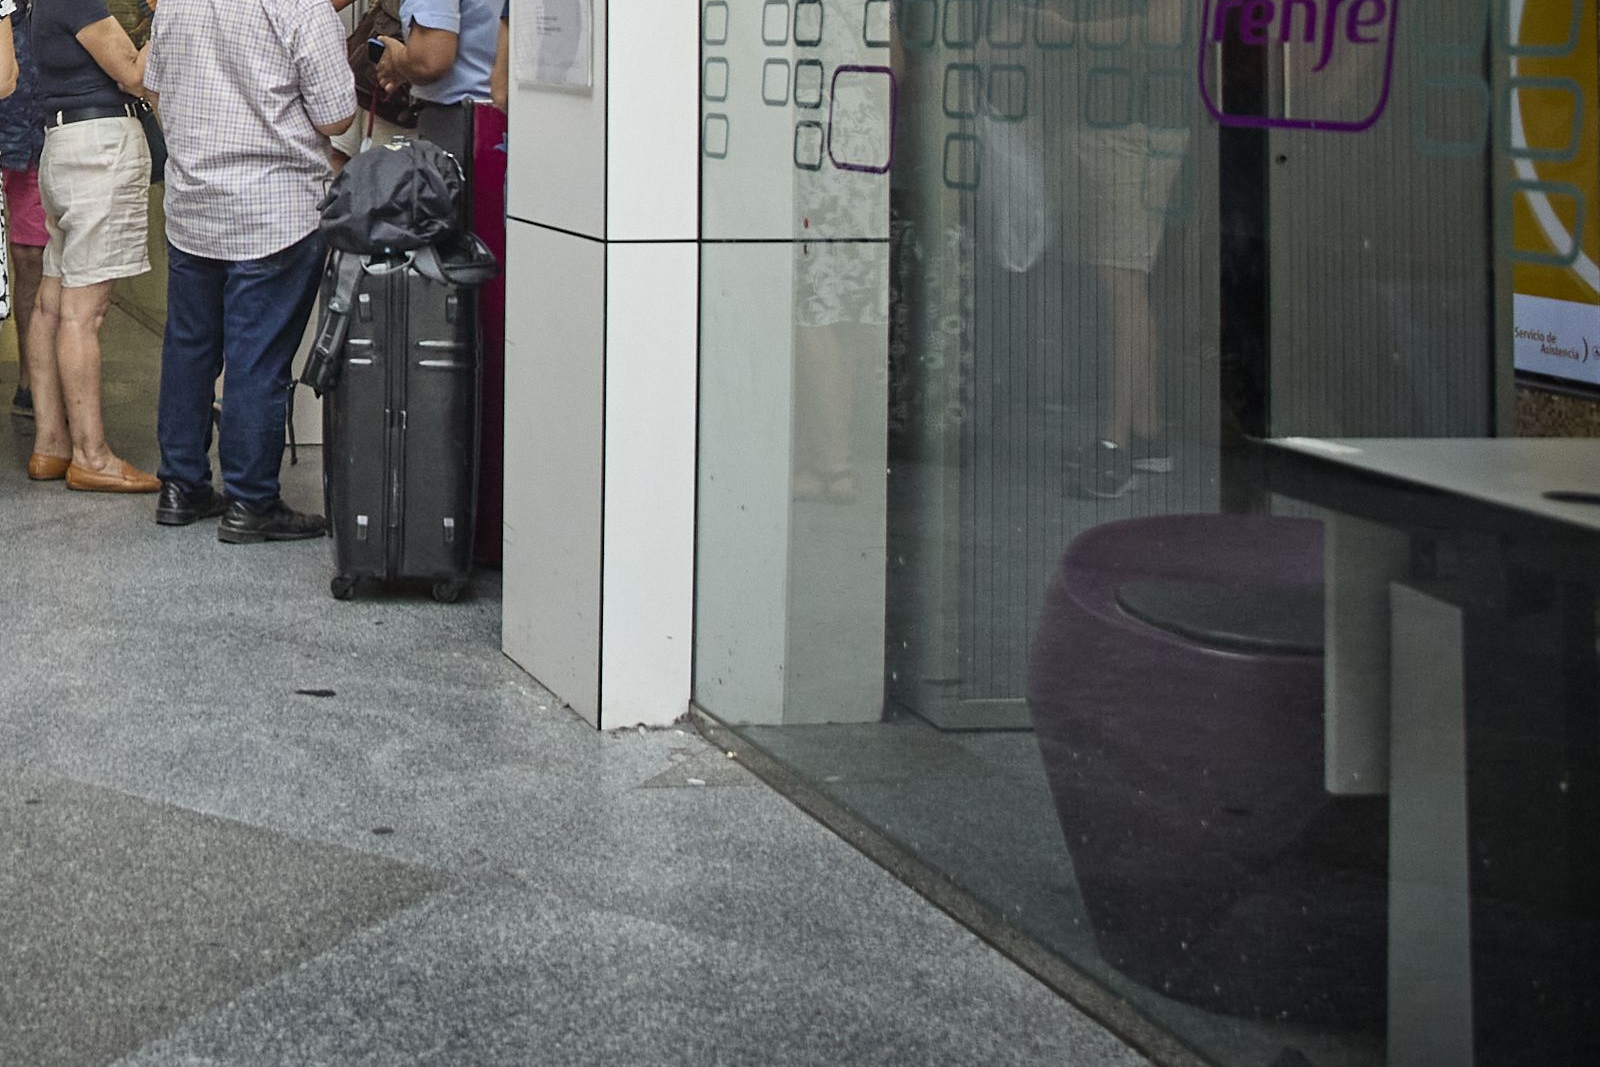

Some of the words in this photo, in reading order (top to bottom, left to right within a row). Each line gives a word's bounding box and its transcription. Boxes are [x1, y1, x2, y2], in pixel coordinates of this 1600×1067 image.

[1514, 326, 1545, 342] Servicio
[1546, 331, 1556, 343] de
[1540, 343, 1579, 359] Asistencia
